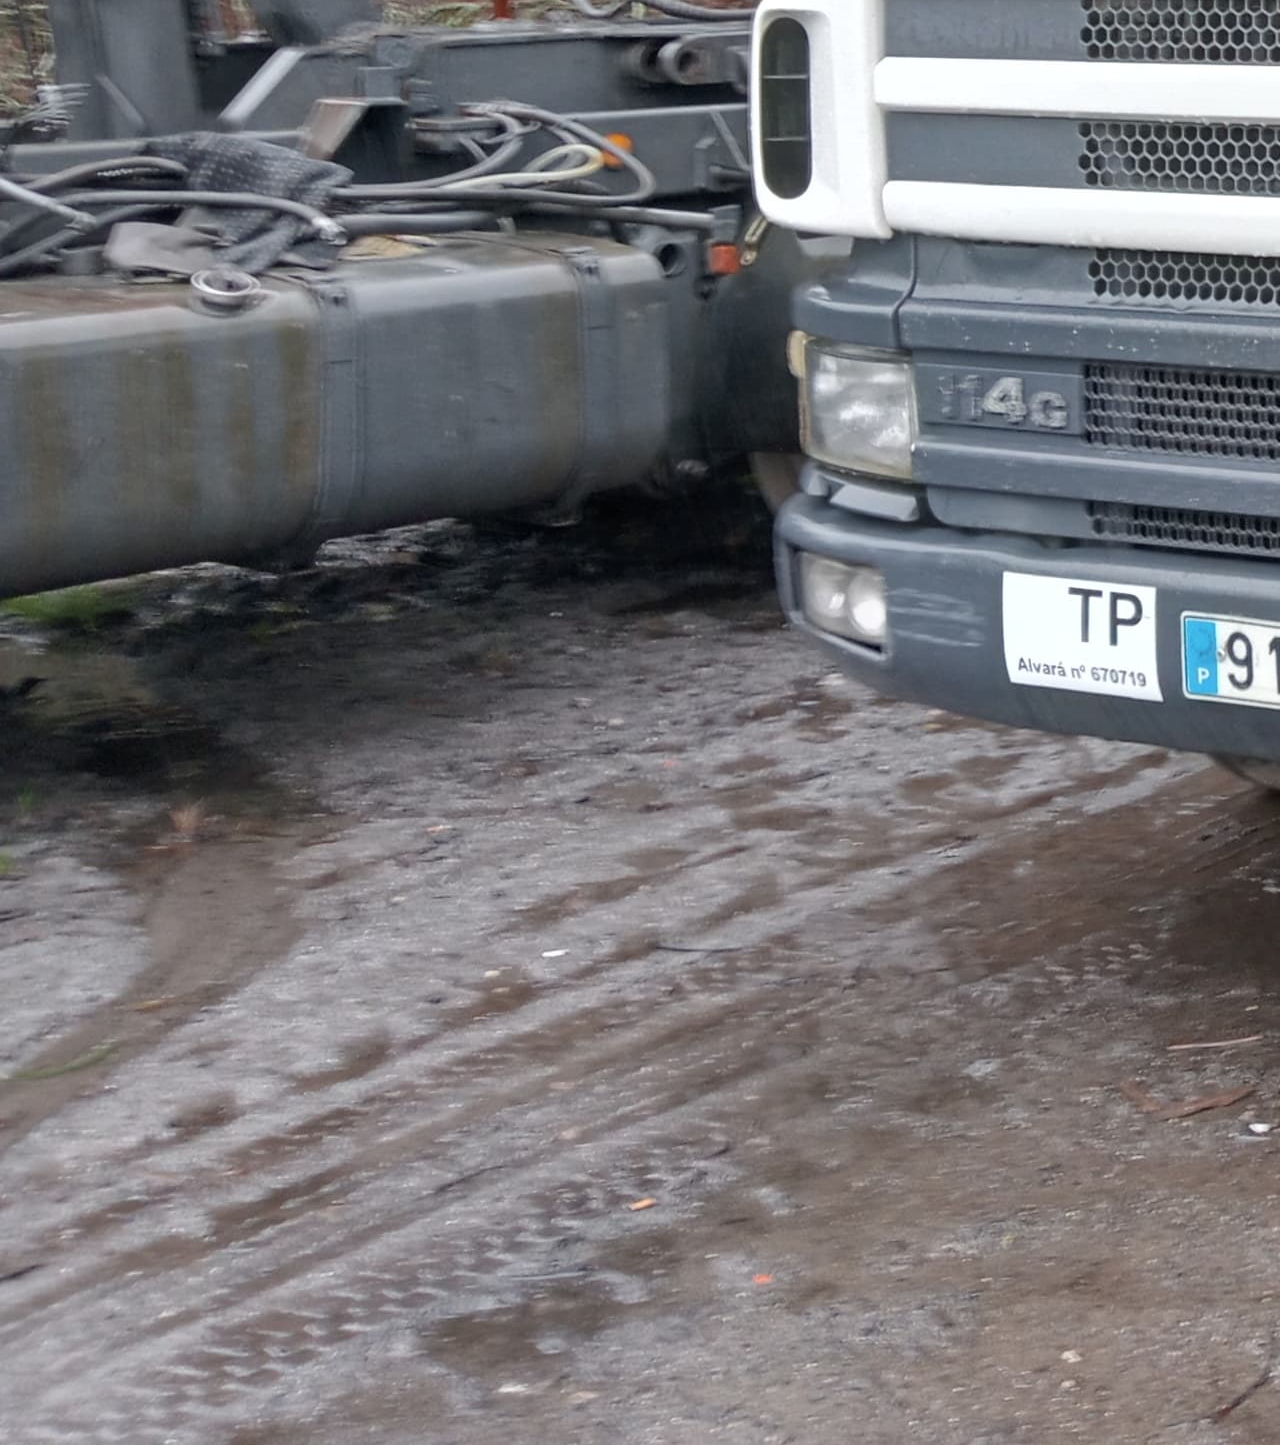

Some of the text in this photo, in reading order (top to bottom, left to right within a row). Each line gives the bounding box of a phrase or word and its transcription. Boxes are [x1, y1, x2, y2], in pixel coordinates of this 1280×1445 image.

[1068, 587, 1143, 646] TP
[1018, 657, 1066, 677] Alvará
[1091, 667, 1146, 687] 670719
[1197, 666, 1211, 685] P
